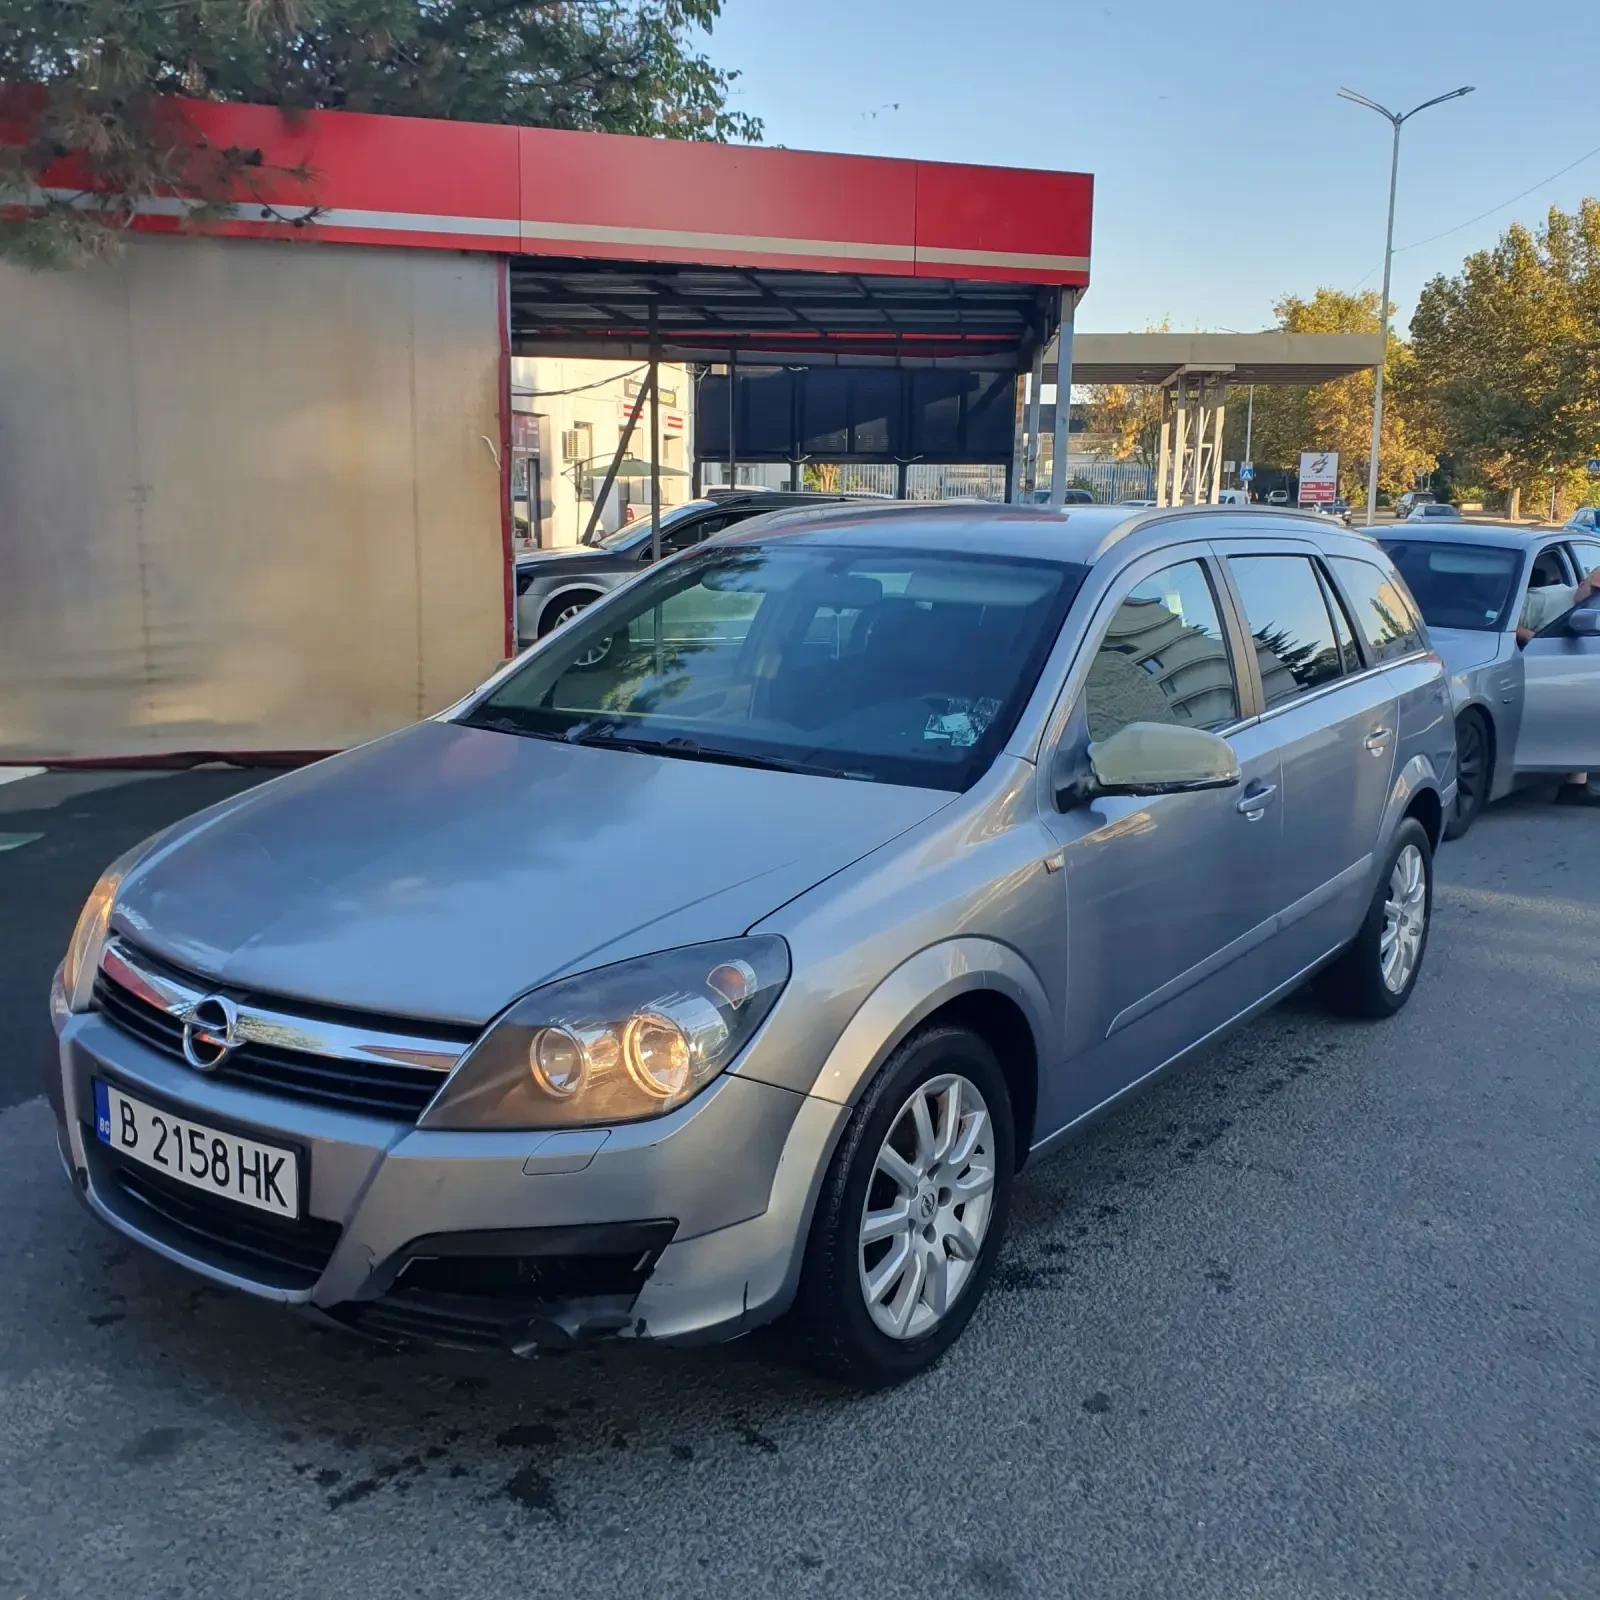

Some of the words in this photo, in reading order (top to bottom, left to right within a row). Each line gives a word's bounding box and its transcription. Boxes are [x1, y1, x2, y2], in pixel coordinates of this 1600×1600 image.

[100, 1117, 110, 1135] BG
[120, 1098, 138, 1148] B
[152, 1116, 230, 1187] 2158
[237, 1146, 288, 1208] HK
